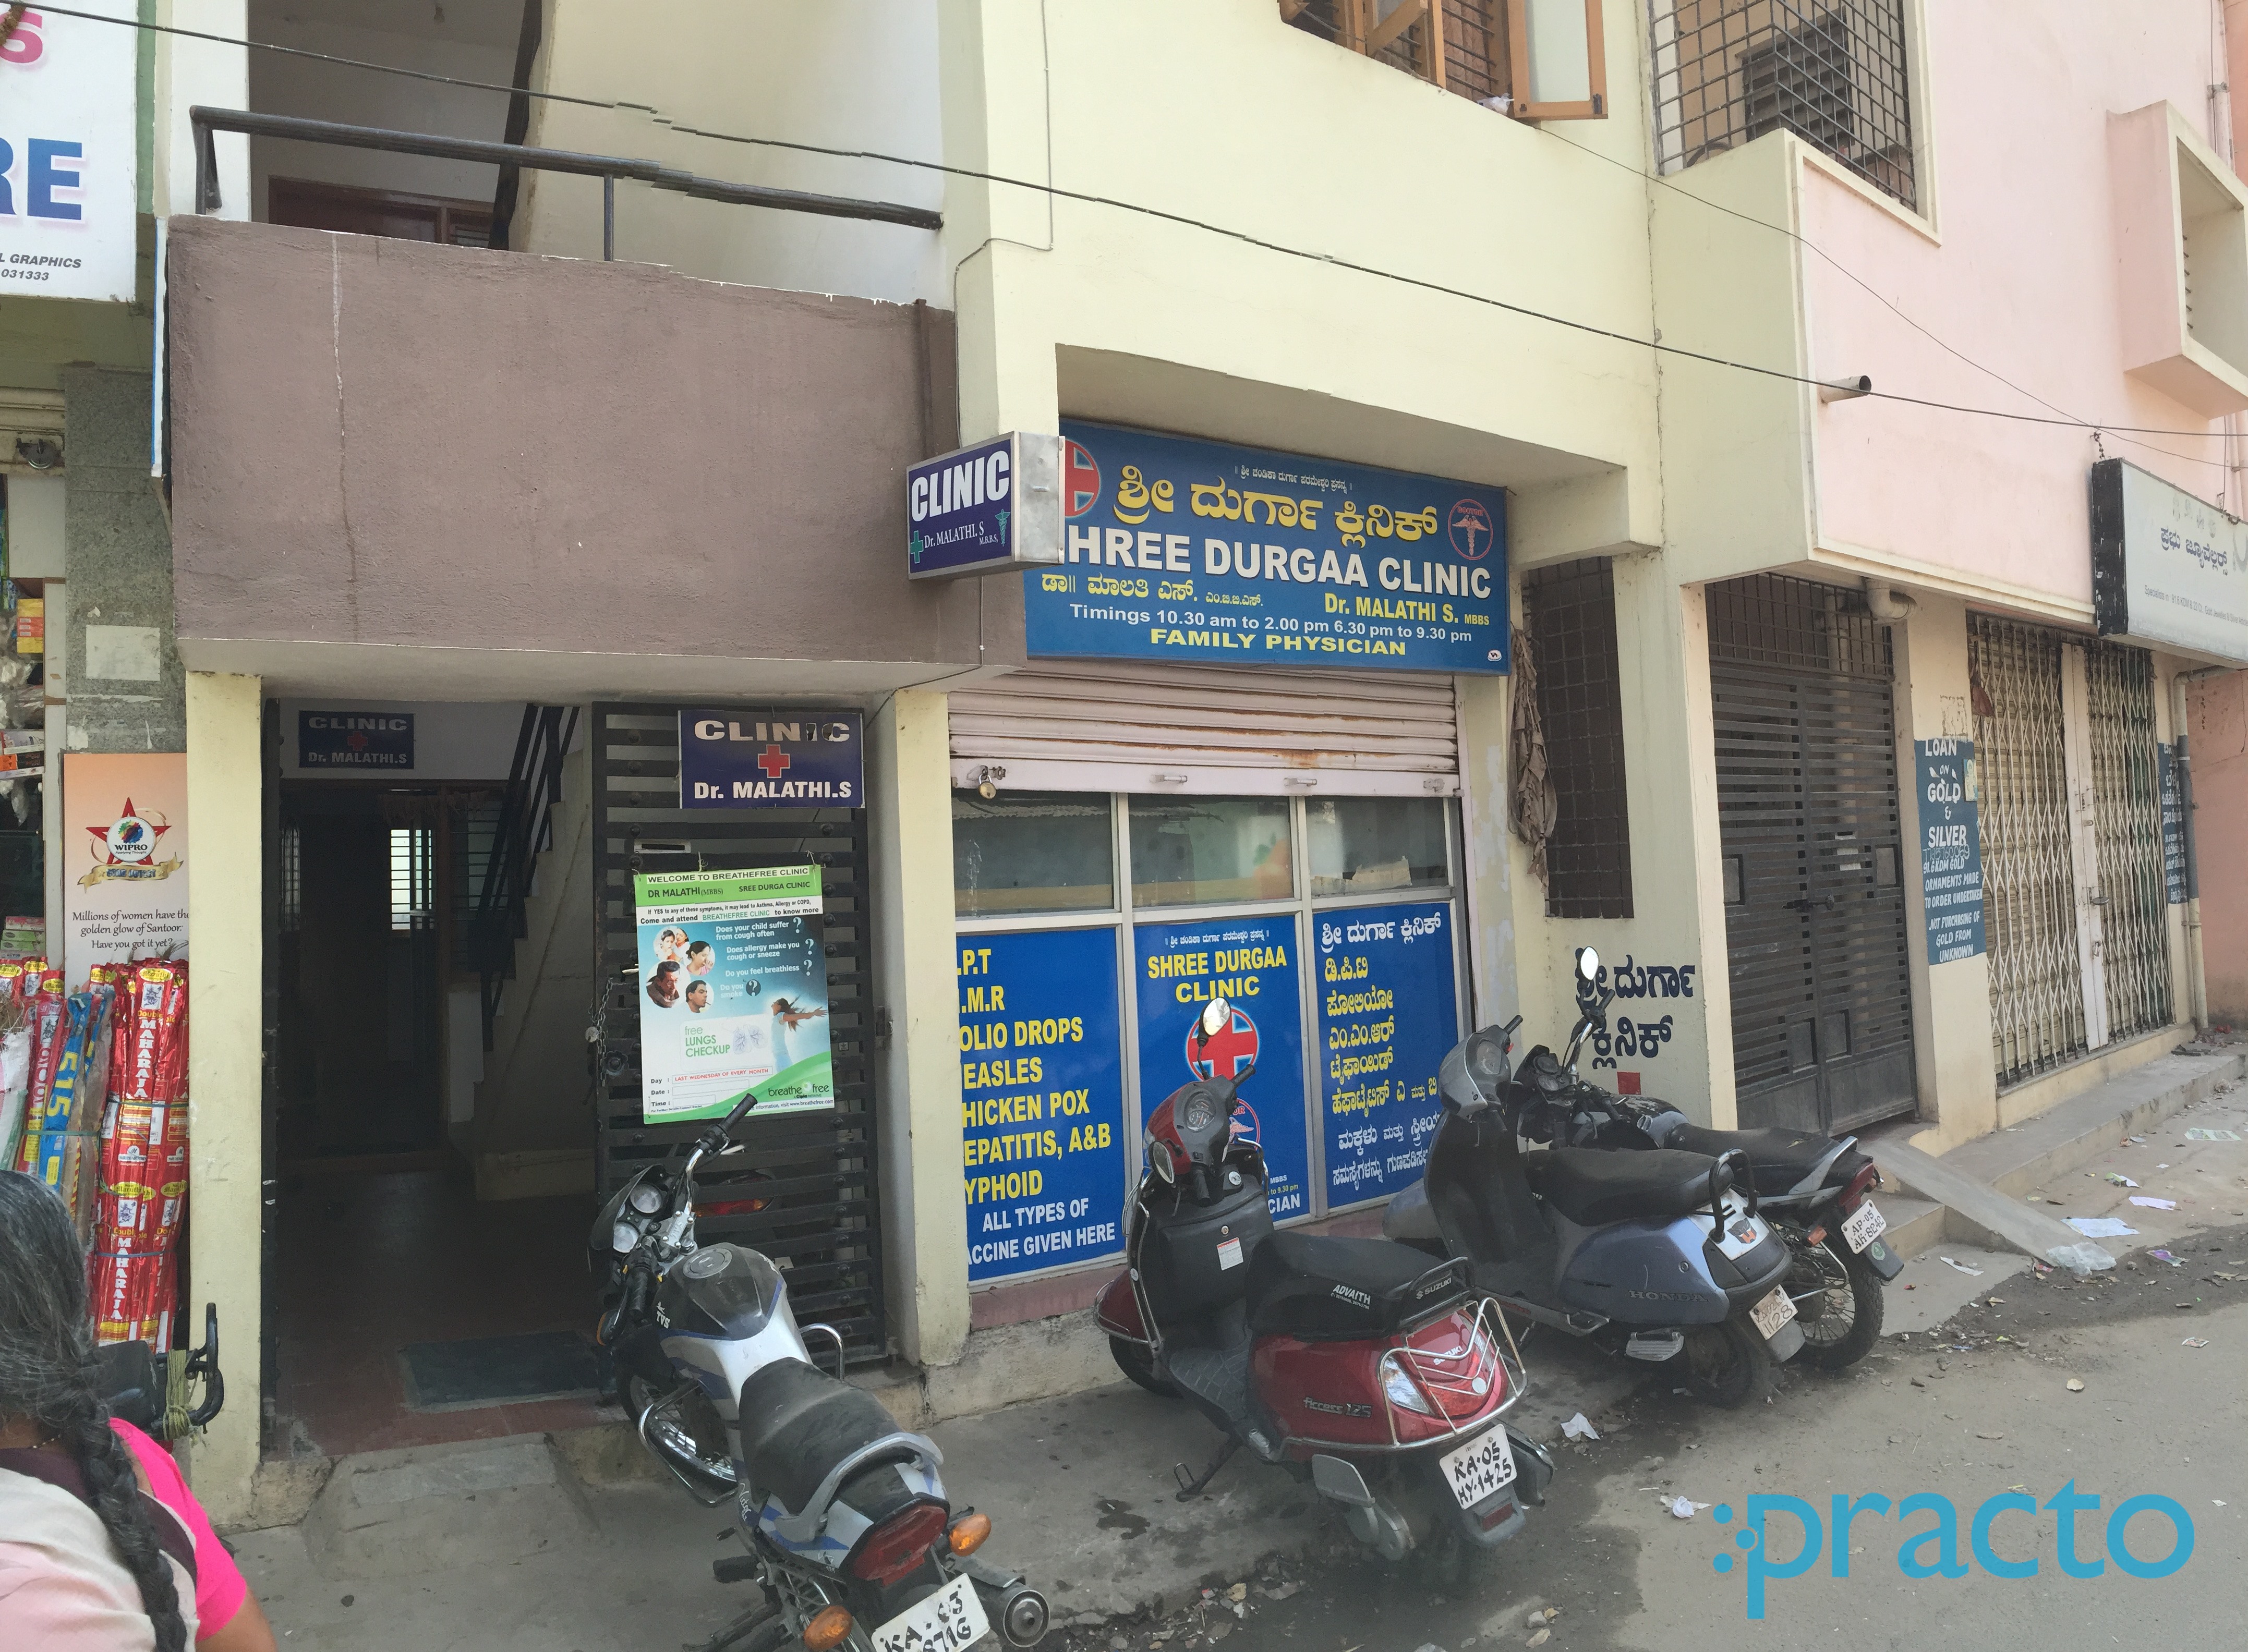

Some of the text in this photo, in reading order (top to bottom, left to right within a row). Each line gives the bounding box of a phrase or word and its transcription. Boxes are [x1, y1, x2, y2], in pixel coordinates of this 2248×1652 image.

[10, 254, 81, 268] GRAPHICS
[912, 451, 1009, 521] CLINIC
[1113, 465, 1438, 549] ಶ್ರೀ ದುರ್ಗಾ ಕ್ಲಿನಿಕ್
[1457, 506, 1483, 517] DOCTOR
[924, 535, 935, 548] Dr.
[1068, 525, 1492, 599] HREE DURGAA CLINIC
[1087, 572, 1149, 599] ಮಾಲತಿ
[1325, 592, 1490, 625] Dr. MALATHI S. MBBS
[1069, 603, 1472, 644] Timings 10.30 am to 2.00 pm 6.30 pm to 9.30 pm
[1151, 628, 1406, 655] FAMILY PHYSICIAN
[308, 717, 407, 731] CLINIC
[694, 720, 850, 742] CLINIC
[308, 752, 326, 762] Dr.
[1925, 738, 1957, 756] LOAN
[1940, 764, 1950, 775] ON
[694, 782, 724, 799] Dr.
[1927, 783, 1961, 803] GOLD
[1928, 825, 1967, 848] SILVER
[1950, 857, 1965, 870] GOLD
[648, 874, 695, 883] WELCOME
[712, 870, 777, 880] BREATHEFREE
[780, 868, 808, 876] CLINIC
[1925, 871, 1979, 892] ORNAMENTS MADE
[648, 889, 660, 898] DR
[662, 886, 700, 897] MALATHI
[1925, 888, 1983, 909] TO ORDER UNDERTAKEN
[72, 912, 108, 921] Millions
[111, 910, 123, 922] of
[155, 909, 175, 919] have
[1941, 910, 1980, 929] PURCHASING OF
[81, 923, 147, 937] golden glow of
[734, 931, 755, 939] cough
[1321, 912, 1441, 953] ಶ್ರೀ ದುರ್ಗಾ ಕ್ಲಿನಿಕ್
[1936, 929, 1972, 948] GOLD FROM
[91, 939, 173, 951] Have you got it yet?
[1939, 944, 1974, 963] UNKNOWN
[765, 965, 800, 973] breathless
[1147, 945, 1287, 979] SHREE DURGAA
[1613, 954, 1696, 998] ದುರ್ಗಾ
[1175, 976, 1260, 1004] CLINIC
[685, 1035, 717, 1047] LUNGS
[959, 1016, 1084, 1052] OLIO DROPS
[134, 1019, 157, 1098] MAHARAJA
[685, 1044, 731, 1058] CHECKUP
[963, 1056, 1043, 1090] EASLES
[962, 1088, 1090, 1128] HICKEN POX
[964, 1122, 1111, 1168] EPATITIS, A&B
[1338, 1123, 1404, 1156] ಮಕ್ಕಳು ಮತ್ತು
[964, 1169, 1043, 1206] YPHOID
[1270, 1174, 1287, 1184] MBBS
[1277, 1185, 1289, 1194] 9.30
[982, 1198, 1090, 1232] ALL TYPES OF
[1023, 1222, 1116, 1258] GIVEN HERE
[1333, 1284, 1371, 1305] ADVAITH
[1424, 1278, 1452, 1295] SUZUKI
[1629, 1290, 1709, 1303] HONDA
[656, 1310, 671, 1329] TVS
[1764, 1304, 1793, 1335] 1128
[1303, 1396, 1372, 1418] Access 125
